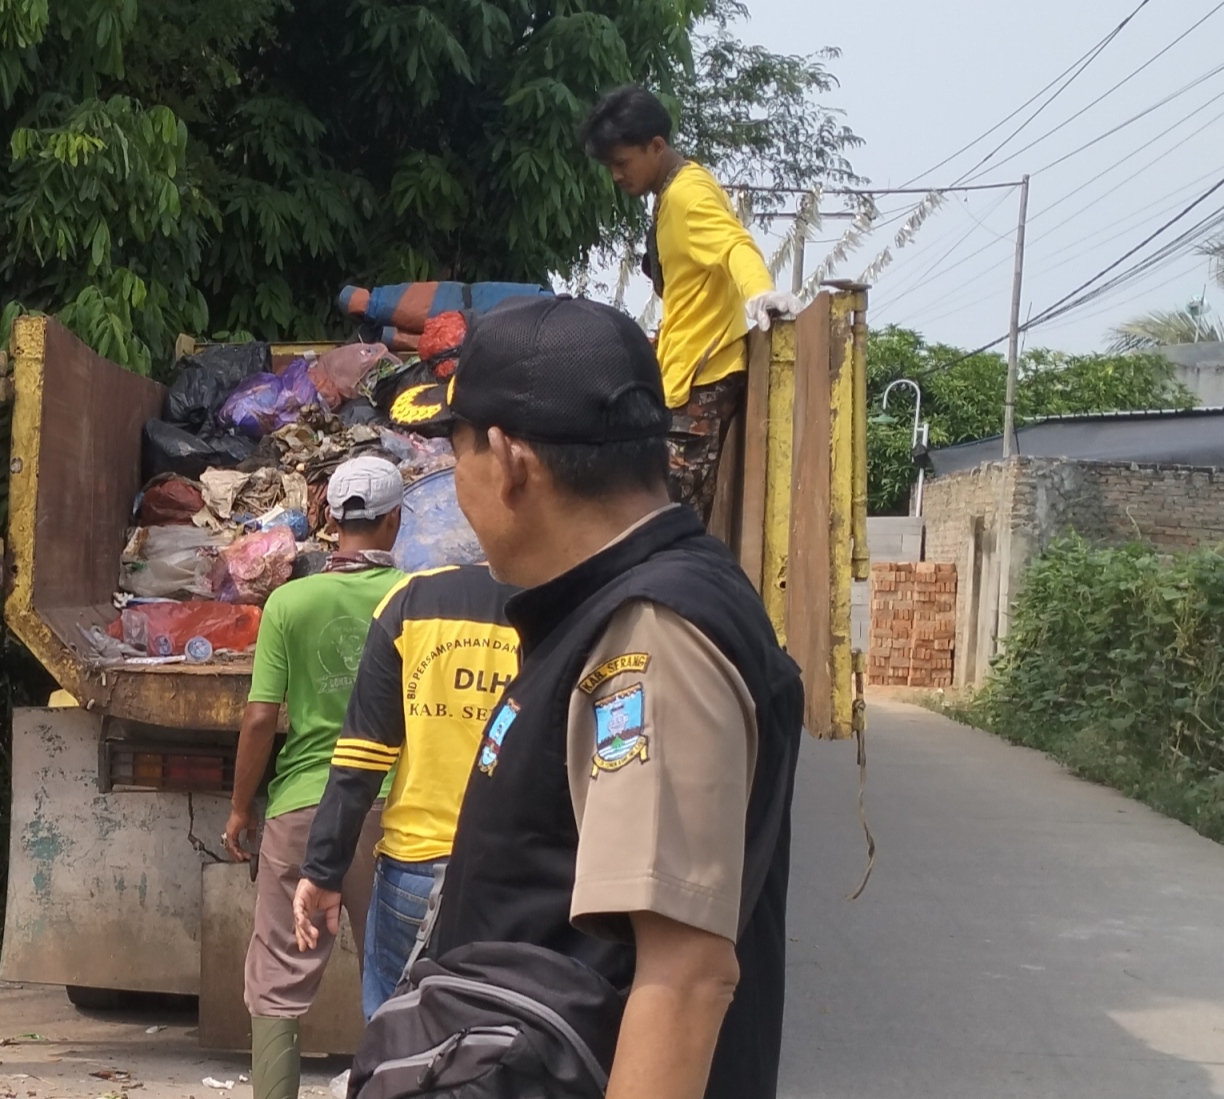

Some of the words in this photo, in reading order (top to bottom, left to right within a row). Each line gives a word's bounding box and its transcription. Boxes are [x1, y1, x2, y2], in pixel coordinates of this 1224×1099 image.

[406, 681, 418, 700] BID
[412, 638, 491, 681] PERSAMPAHAN
[453, 667, 512, 694] DLH
[408, 703, 454, 718] KAB.
[461, 705, 494, 722] SE
